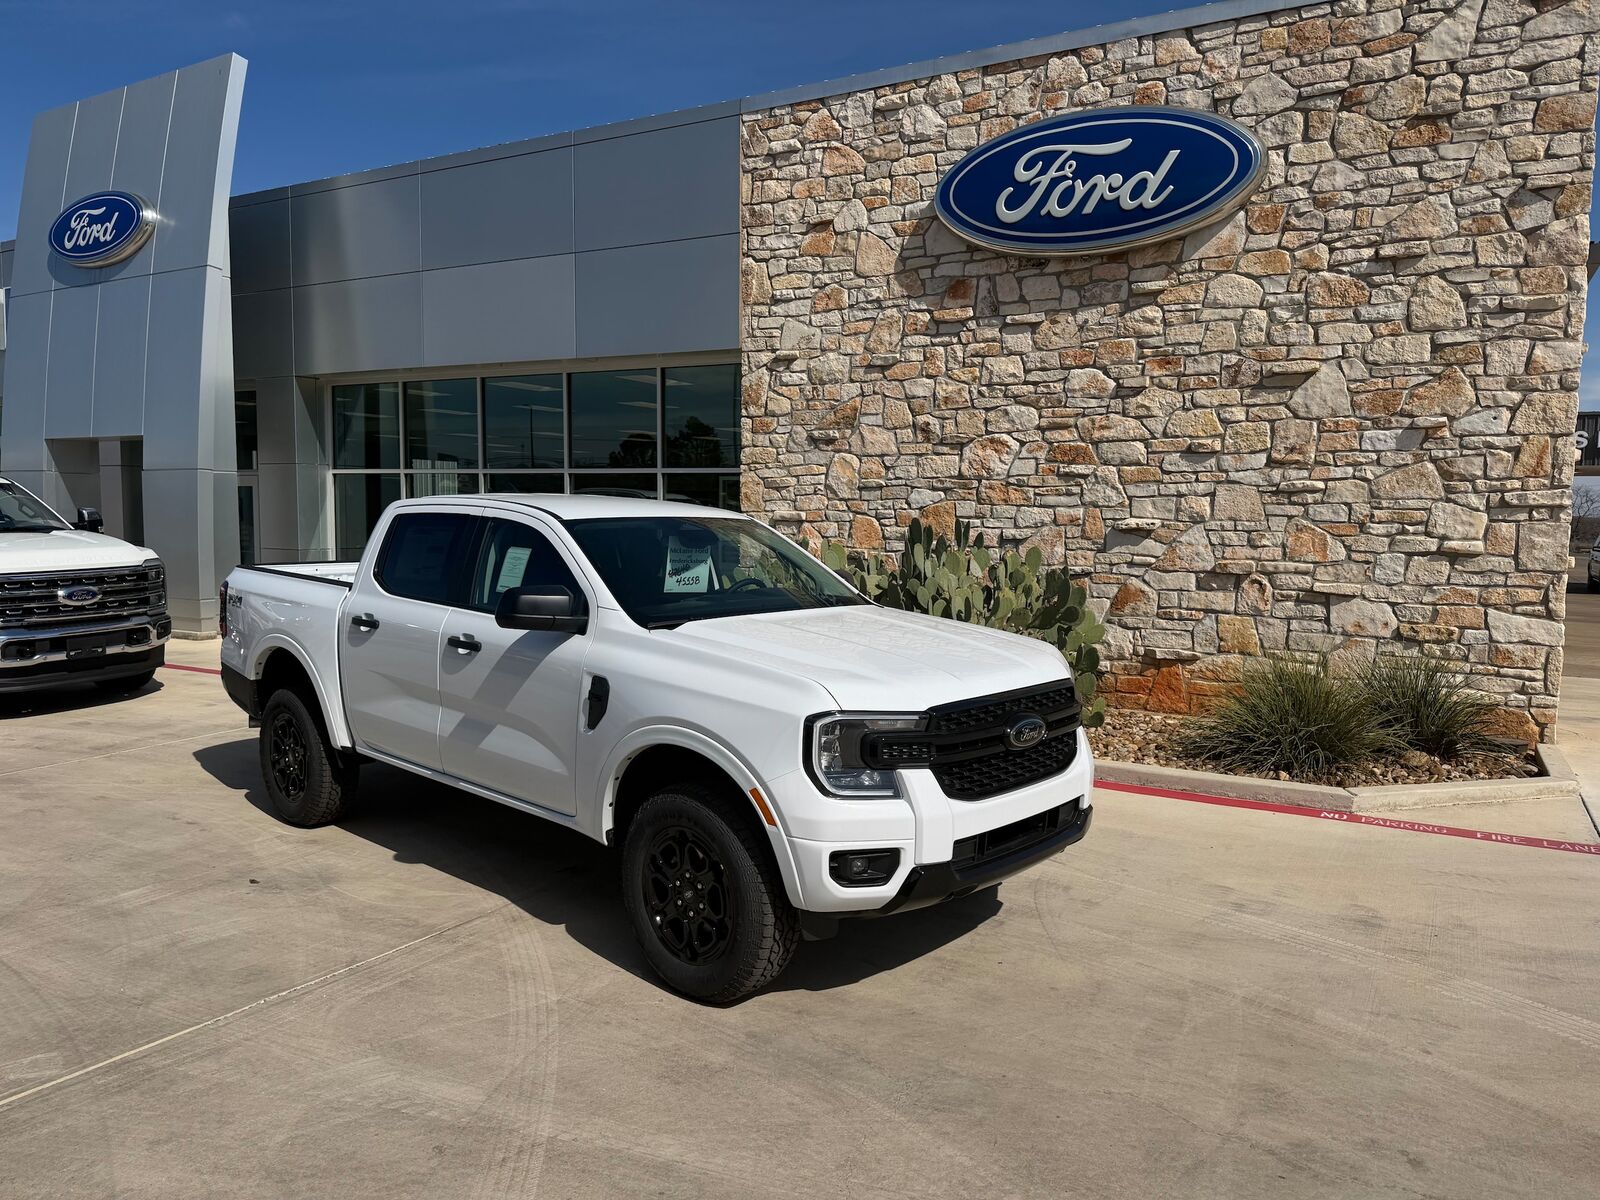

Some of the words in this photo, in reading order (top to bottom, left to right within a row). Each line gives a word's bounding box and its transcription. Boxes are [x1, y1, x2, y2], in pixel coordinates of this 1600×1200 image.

[995, 138, 1181, 224] Ford
[64, 206, 120, 250] Ford
[72, 591, 93, 600] Ford
[676, 576, 700, 586] 45558
[1020, 724, 1040, 741] Ford
[1320, 811, 1348, 820] NO
[1361, 816, 1447, 834] PARKING
[1476, 832, 1528, 844] FIRE
[1543, 840, 1600, 854] LANE
